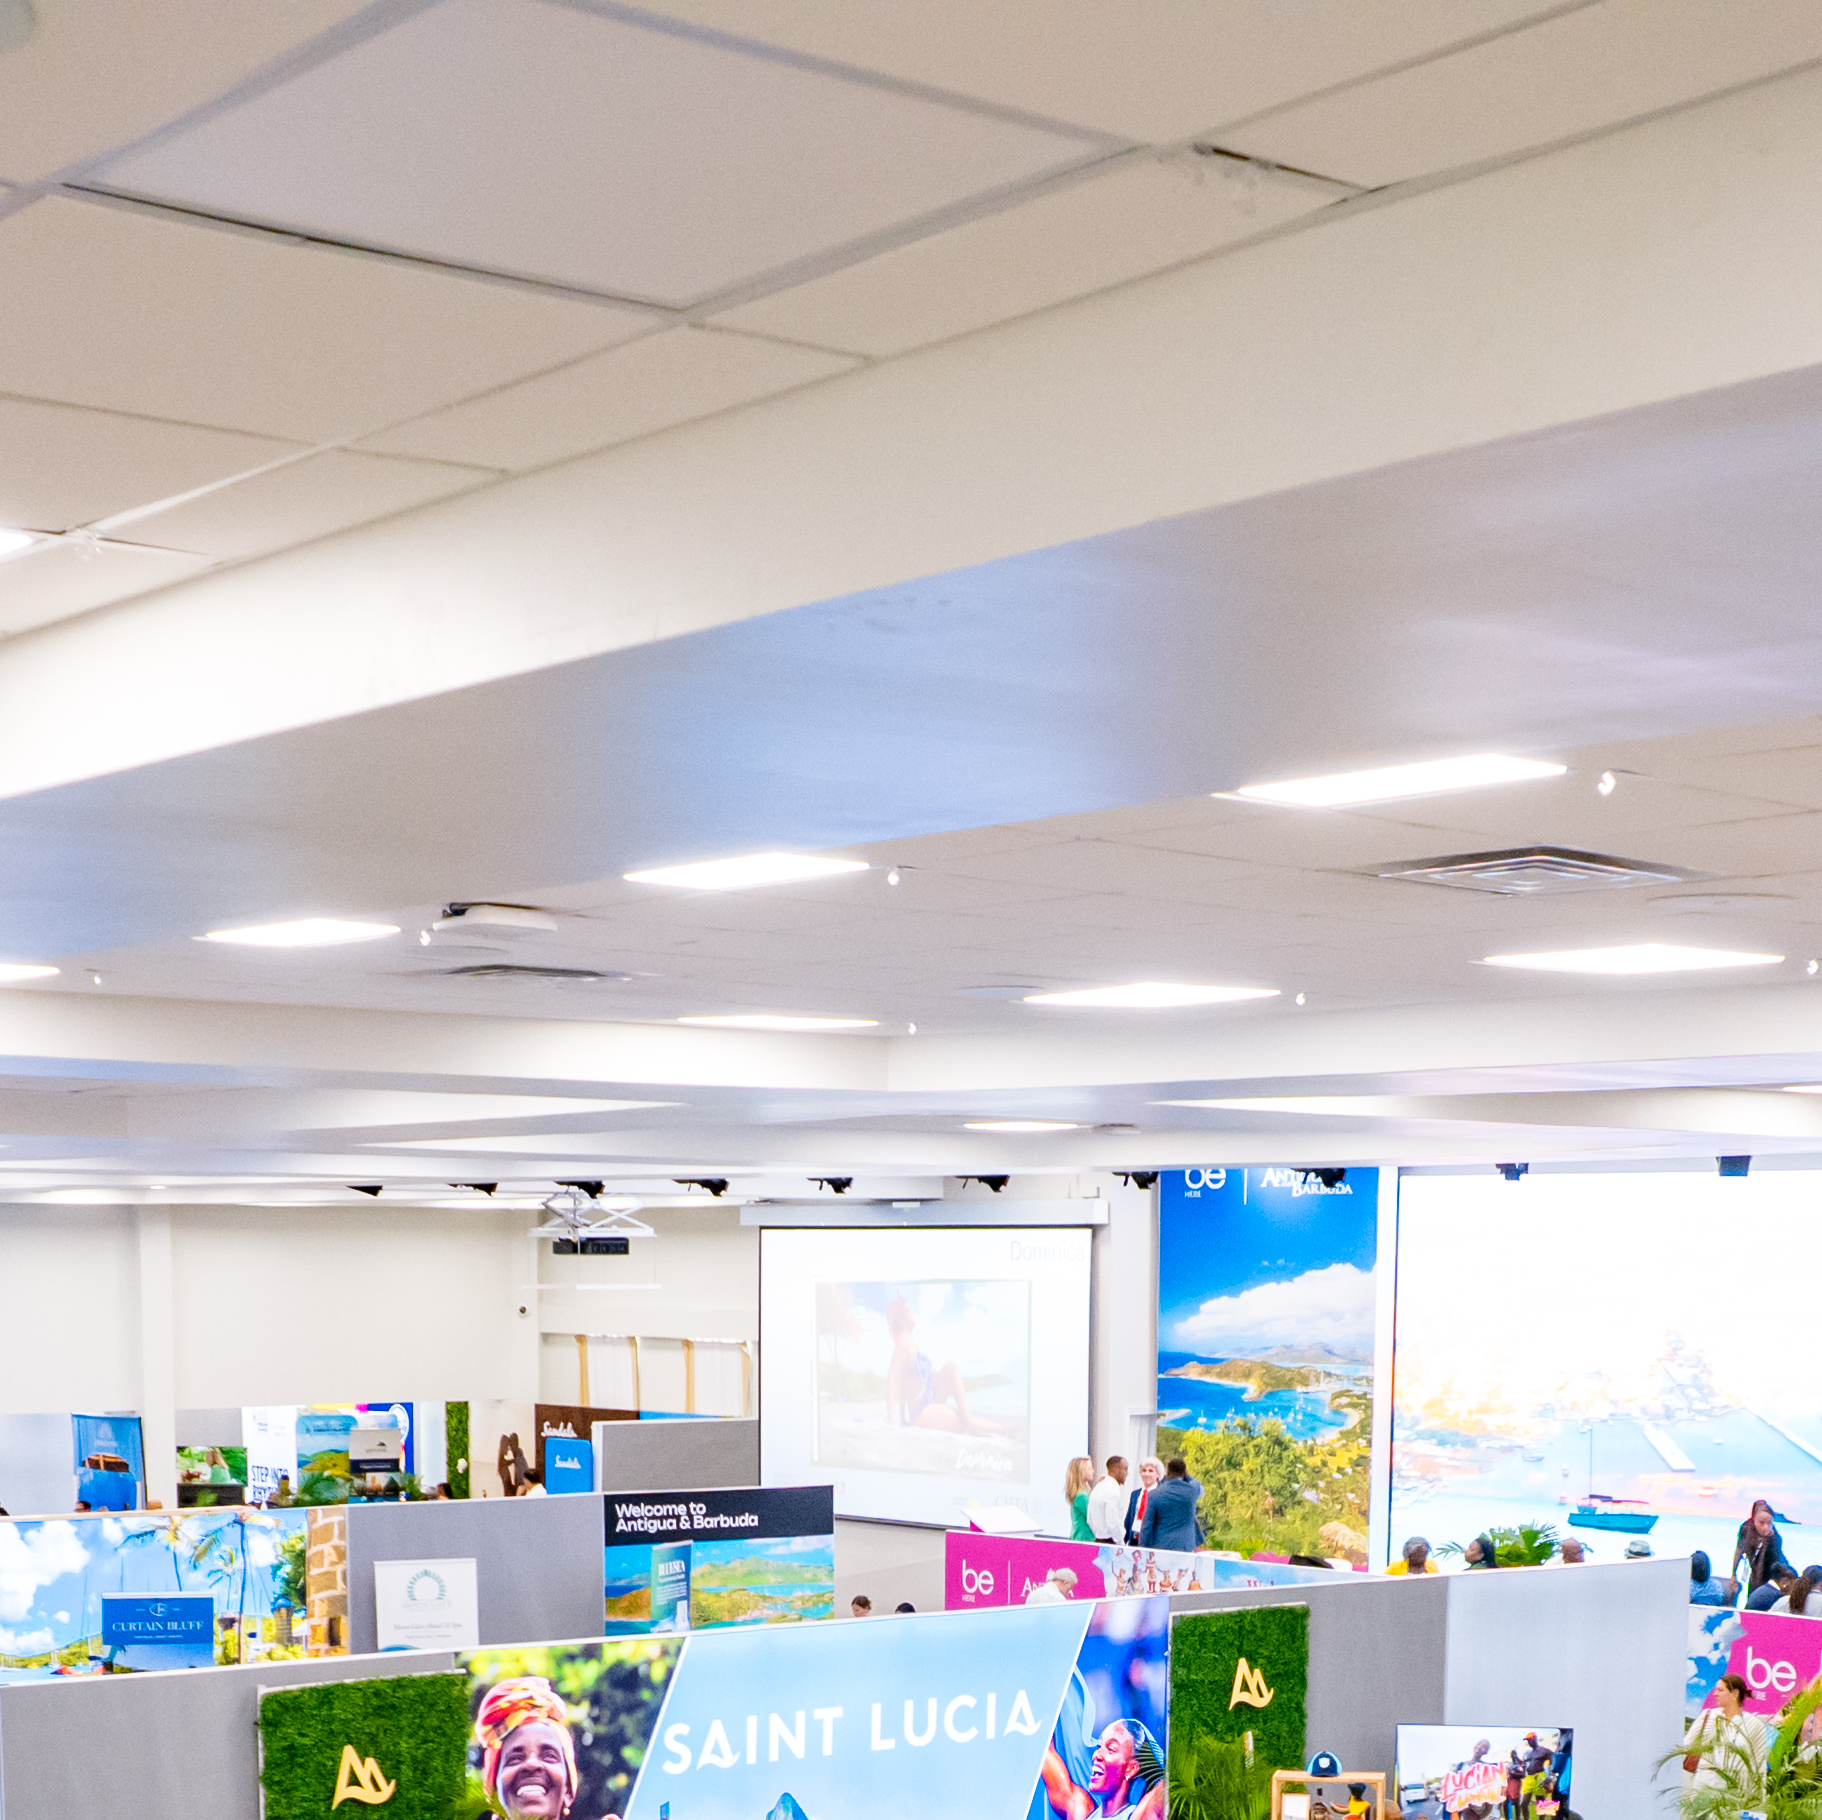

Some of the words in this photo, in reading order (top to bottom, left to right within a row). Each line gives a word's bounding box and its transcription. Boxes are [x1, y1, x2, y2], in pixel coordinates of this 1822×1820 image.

[1010, 1240, 1086, 1262] Dominica
[614, 1502, 687, 1518] Welcome
[688, 1501, 707, 1516] to
[615, 1517, 677, 1534] Antigua
[679, 1515, 692, 1530] &
[693, 1512, 759, 1529] Barbuda
[962, 1559, 994, 1596] be
[112, 1621, 164, 1632] CURTAIN
[167, 1620, 204, 1631] BLUFF
[1746, 1645, 1797, 1692] be
[662, 1705, 845, 1776] SAINT
[870, 1688, 1043, 1753] LUCIA
